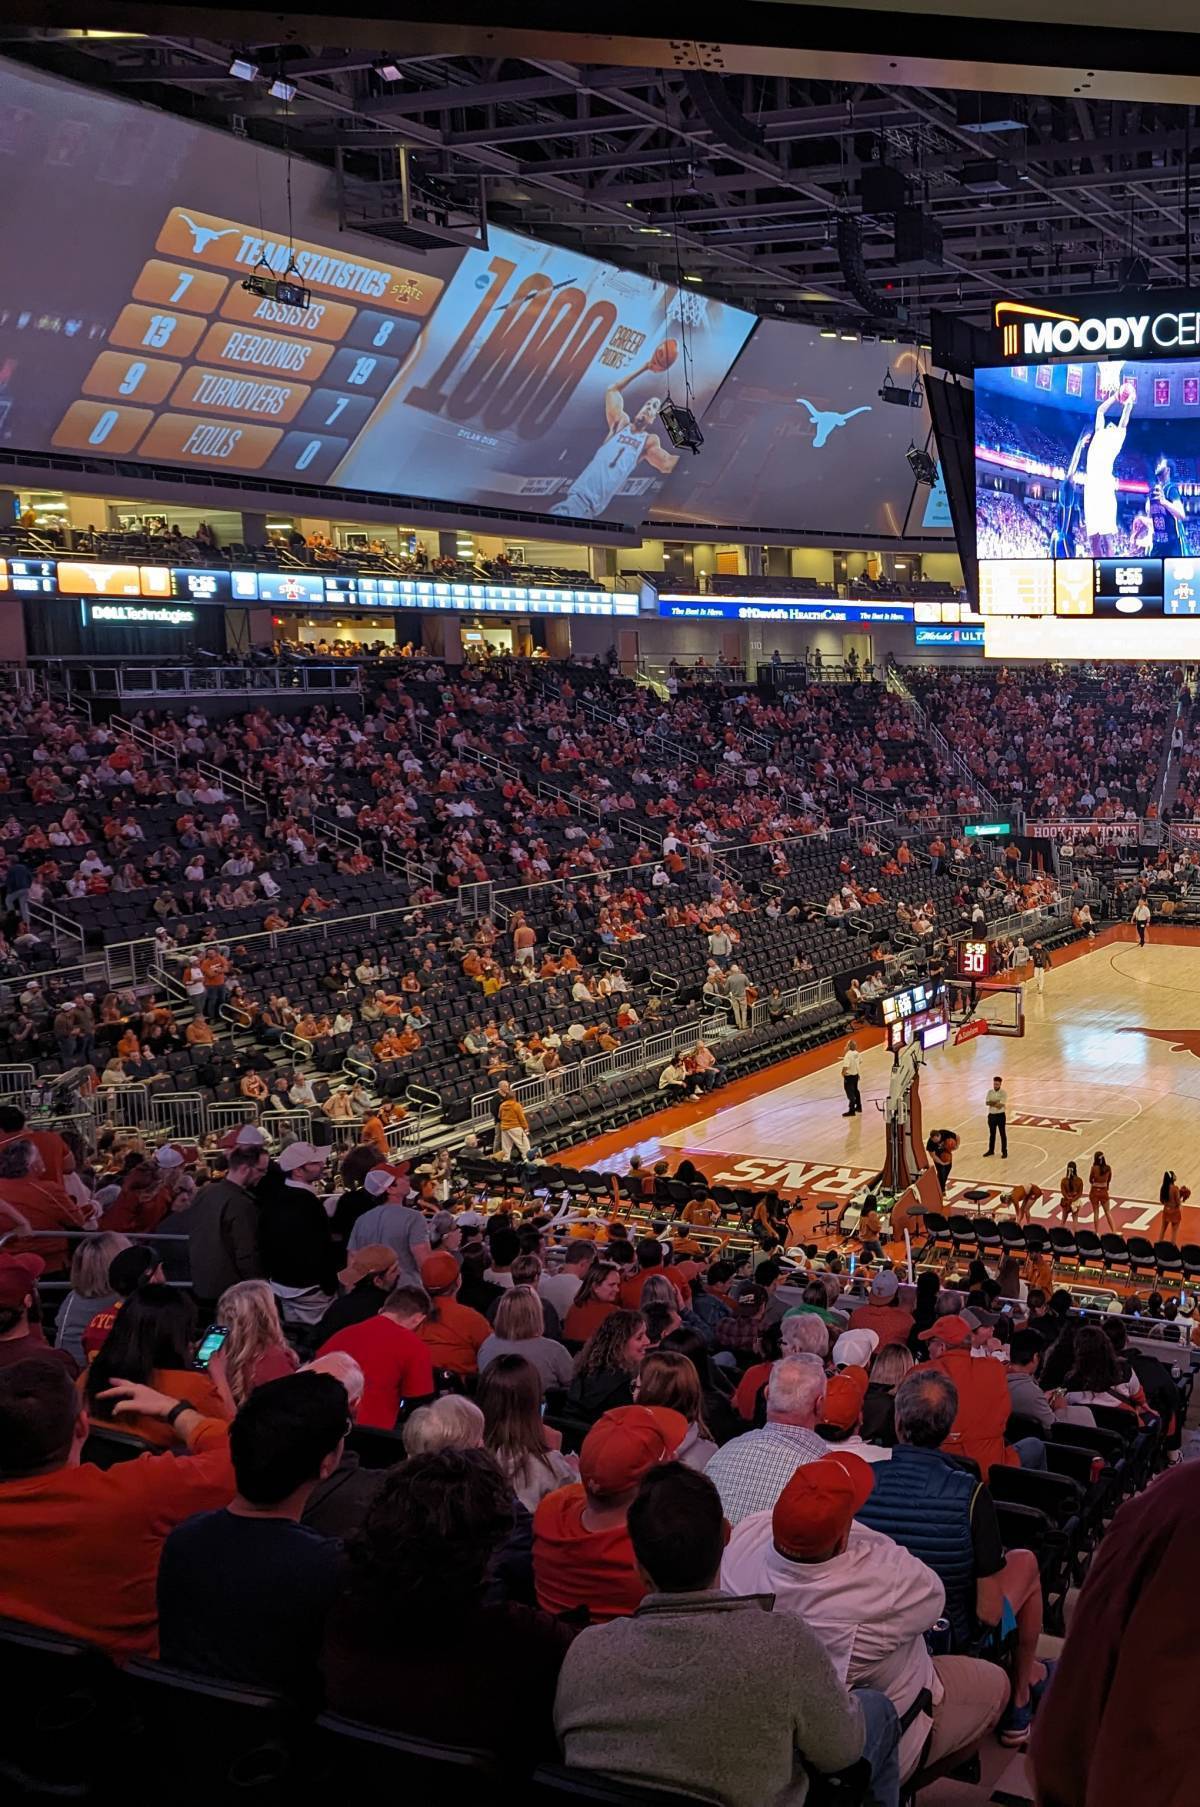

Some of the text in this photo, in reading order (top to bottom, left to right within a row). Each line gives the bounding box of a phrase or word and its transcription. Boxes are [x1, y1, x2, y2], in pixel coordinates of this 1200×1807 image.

[235, 236, 391, 297] TEAM STATISTICS
[169, 273, 194, 302] 7
[390, 283, 423, 302] STATE
[254, 298, 325, 330] ASSISTS
[141, 315, 176, 348] 13
[373, 321, 396, 347] 8
[1024, 315, 1149, 354] MOODY
[221, 333, 312, 371] REBOUNDS
[403, 256, 618, 440] 1000
[119, 363, 147, 395] 9
[347, 357, 376, 385] 19
[190, 375, 291, 415] TURNOVERS
[325, 398, 348, 425] 7
[88, 410, 119, 445] 0
[182, 424, 242, 458] FOULS
[295, 441, 322, 470] 0
[92, 606, 194, 624] DELL Technologies
[685, 608, 699, 616] Best
[860, 612, 871, 620] The
[751, 641, 762, 650] 110
[961, 630, 985, 641] ULT
[1034, 826, 1065, 839] HOOK
[963, 954, 984, 972] 30
